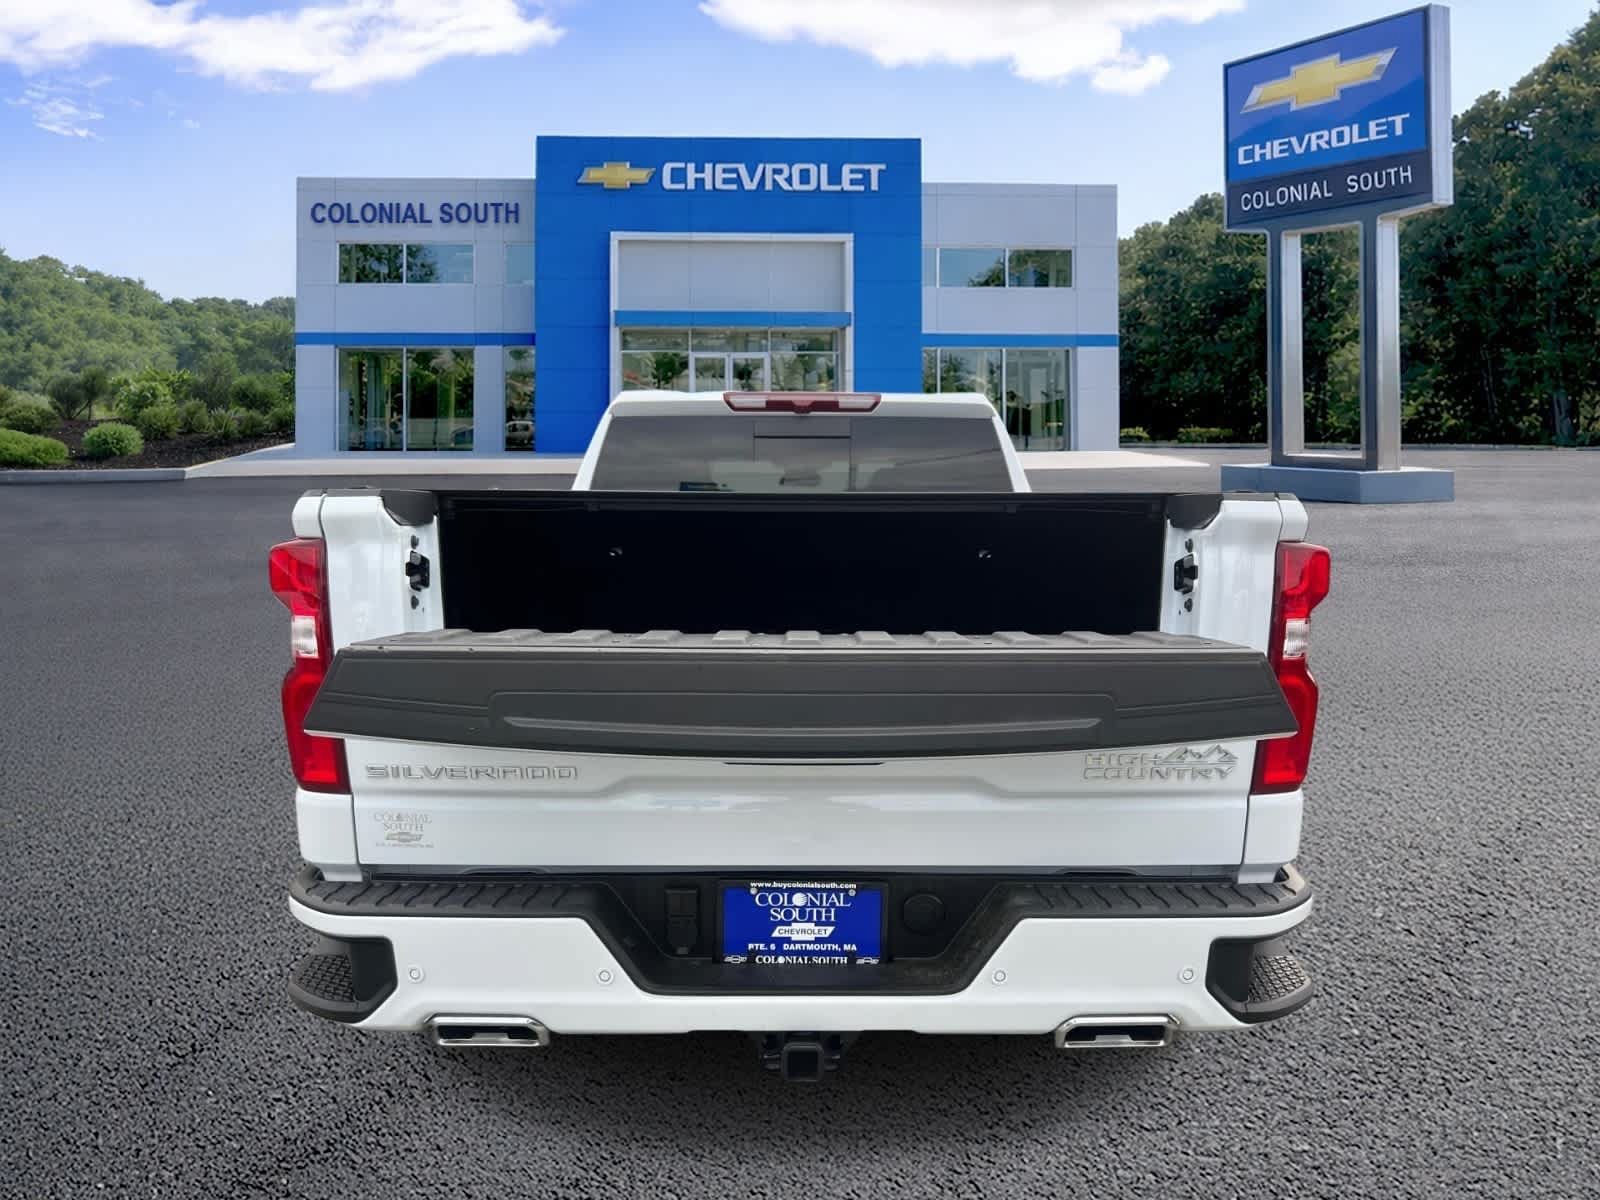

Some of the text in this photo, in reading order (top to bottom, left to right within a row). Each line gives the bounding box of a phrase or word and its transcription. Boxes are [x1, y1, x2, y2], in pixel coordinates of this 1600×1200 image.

[1237, 112, 1410, 165] CHEVROLET
[662, 162, 887, 192] CHEVROLET
[1240, 165, 1412, 211] COLONIAL SOUTH
[310, 202, 520, 224] COLONIAL SOUTH
[365, 764, 578, 780] SILVERADO
[1083, 766, 1235, 780] COUNTRY
[383, 823, 424, 832] SOUTH
[750, 881, 857, 889] www.buycolonialsouth.com
[755, 892, 851, 907] COLONIAL
[770, 908, 836, 922] SOUTH
[777, 928, 828, 936] CHEVROLET
[783, 943, 841, 952] DARTMOUTH,
[755, 955, 811, 964] COLONIAL
[812, 956, 848, 965] SOUTH
